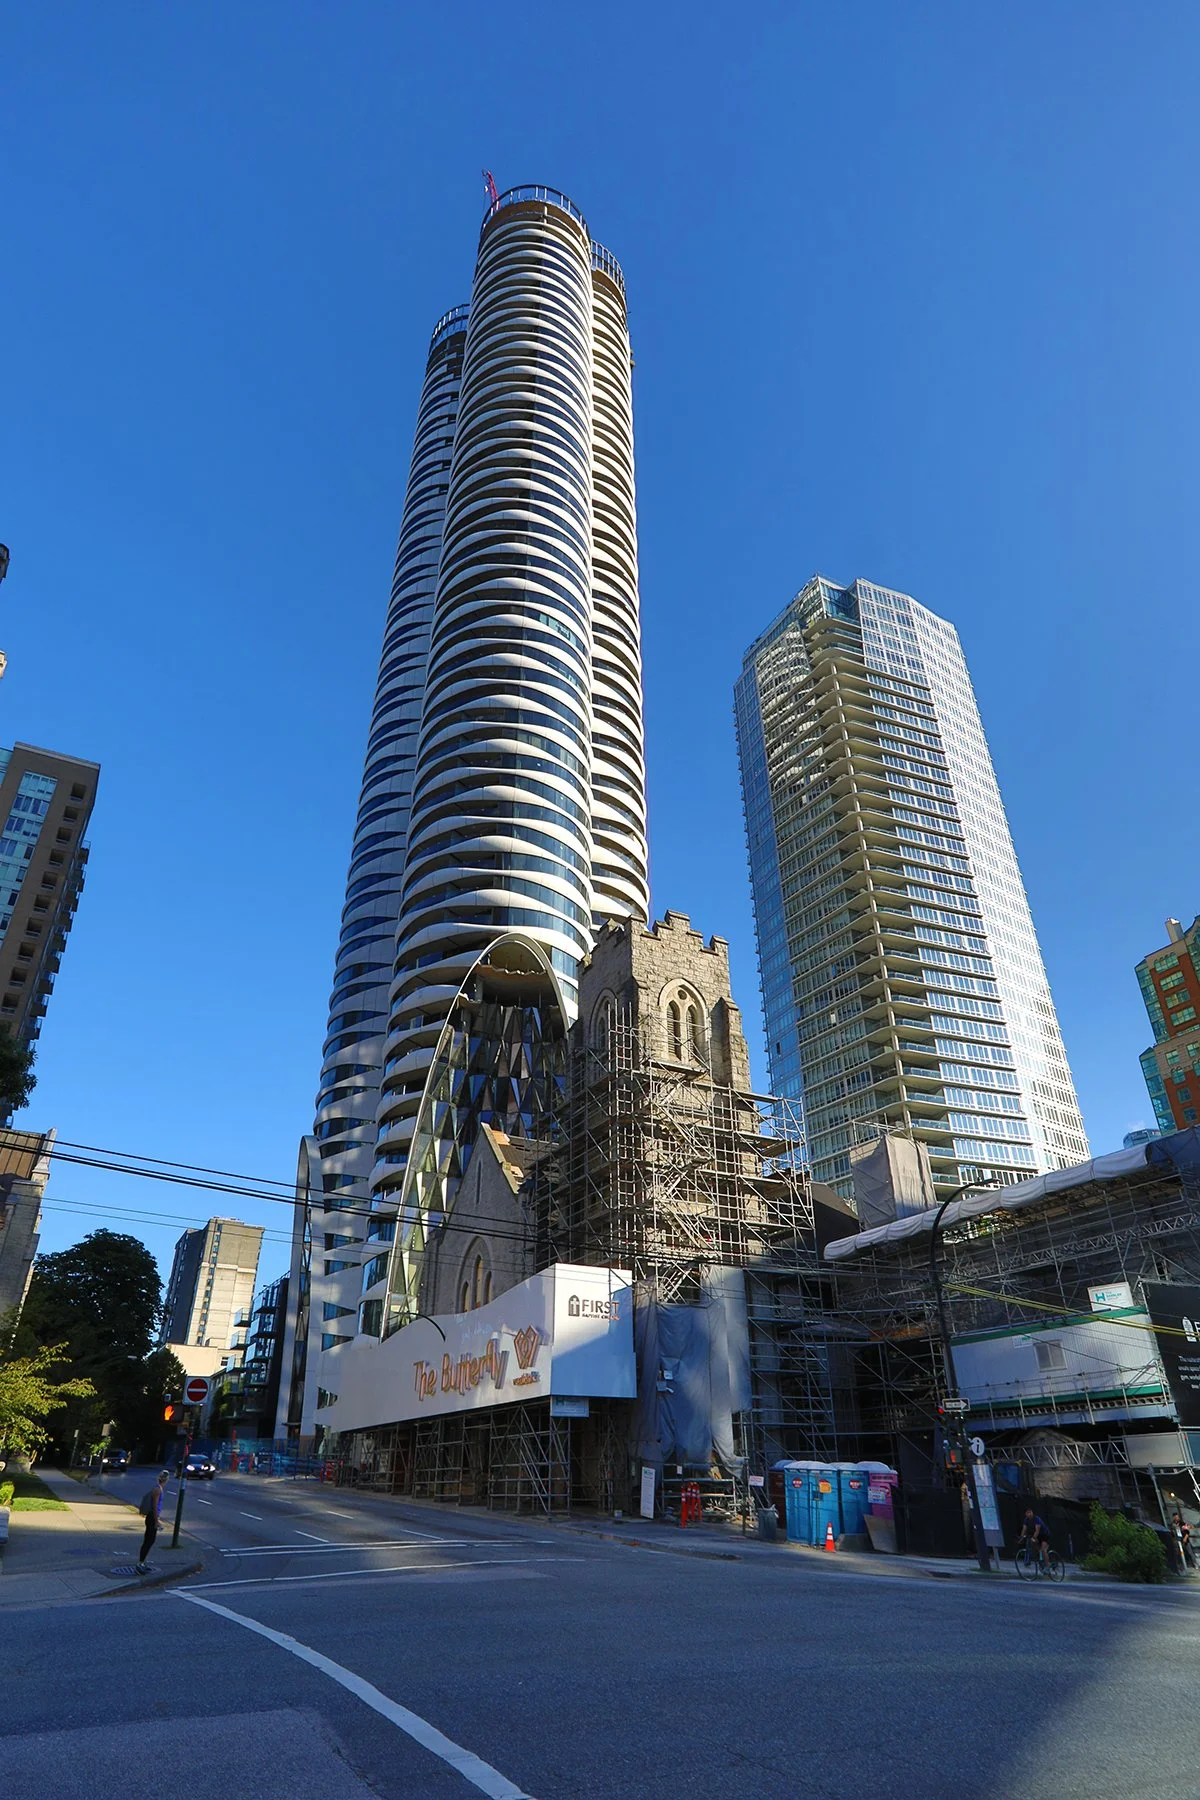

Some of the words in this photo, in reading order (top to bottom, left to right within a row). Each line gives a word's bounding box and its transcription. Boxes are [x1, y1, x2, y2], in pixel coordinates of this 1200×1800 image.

[582, 1299, 620, 1314] FIRST
[413, 1360, 438, 1401] The
[441, 1339, 510, 1395] Butterfly
